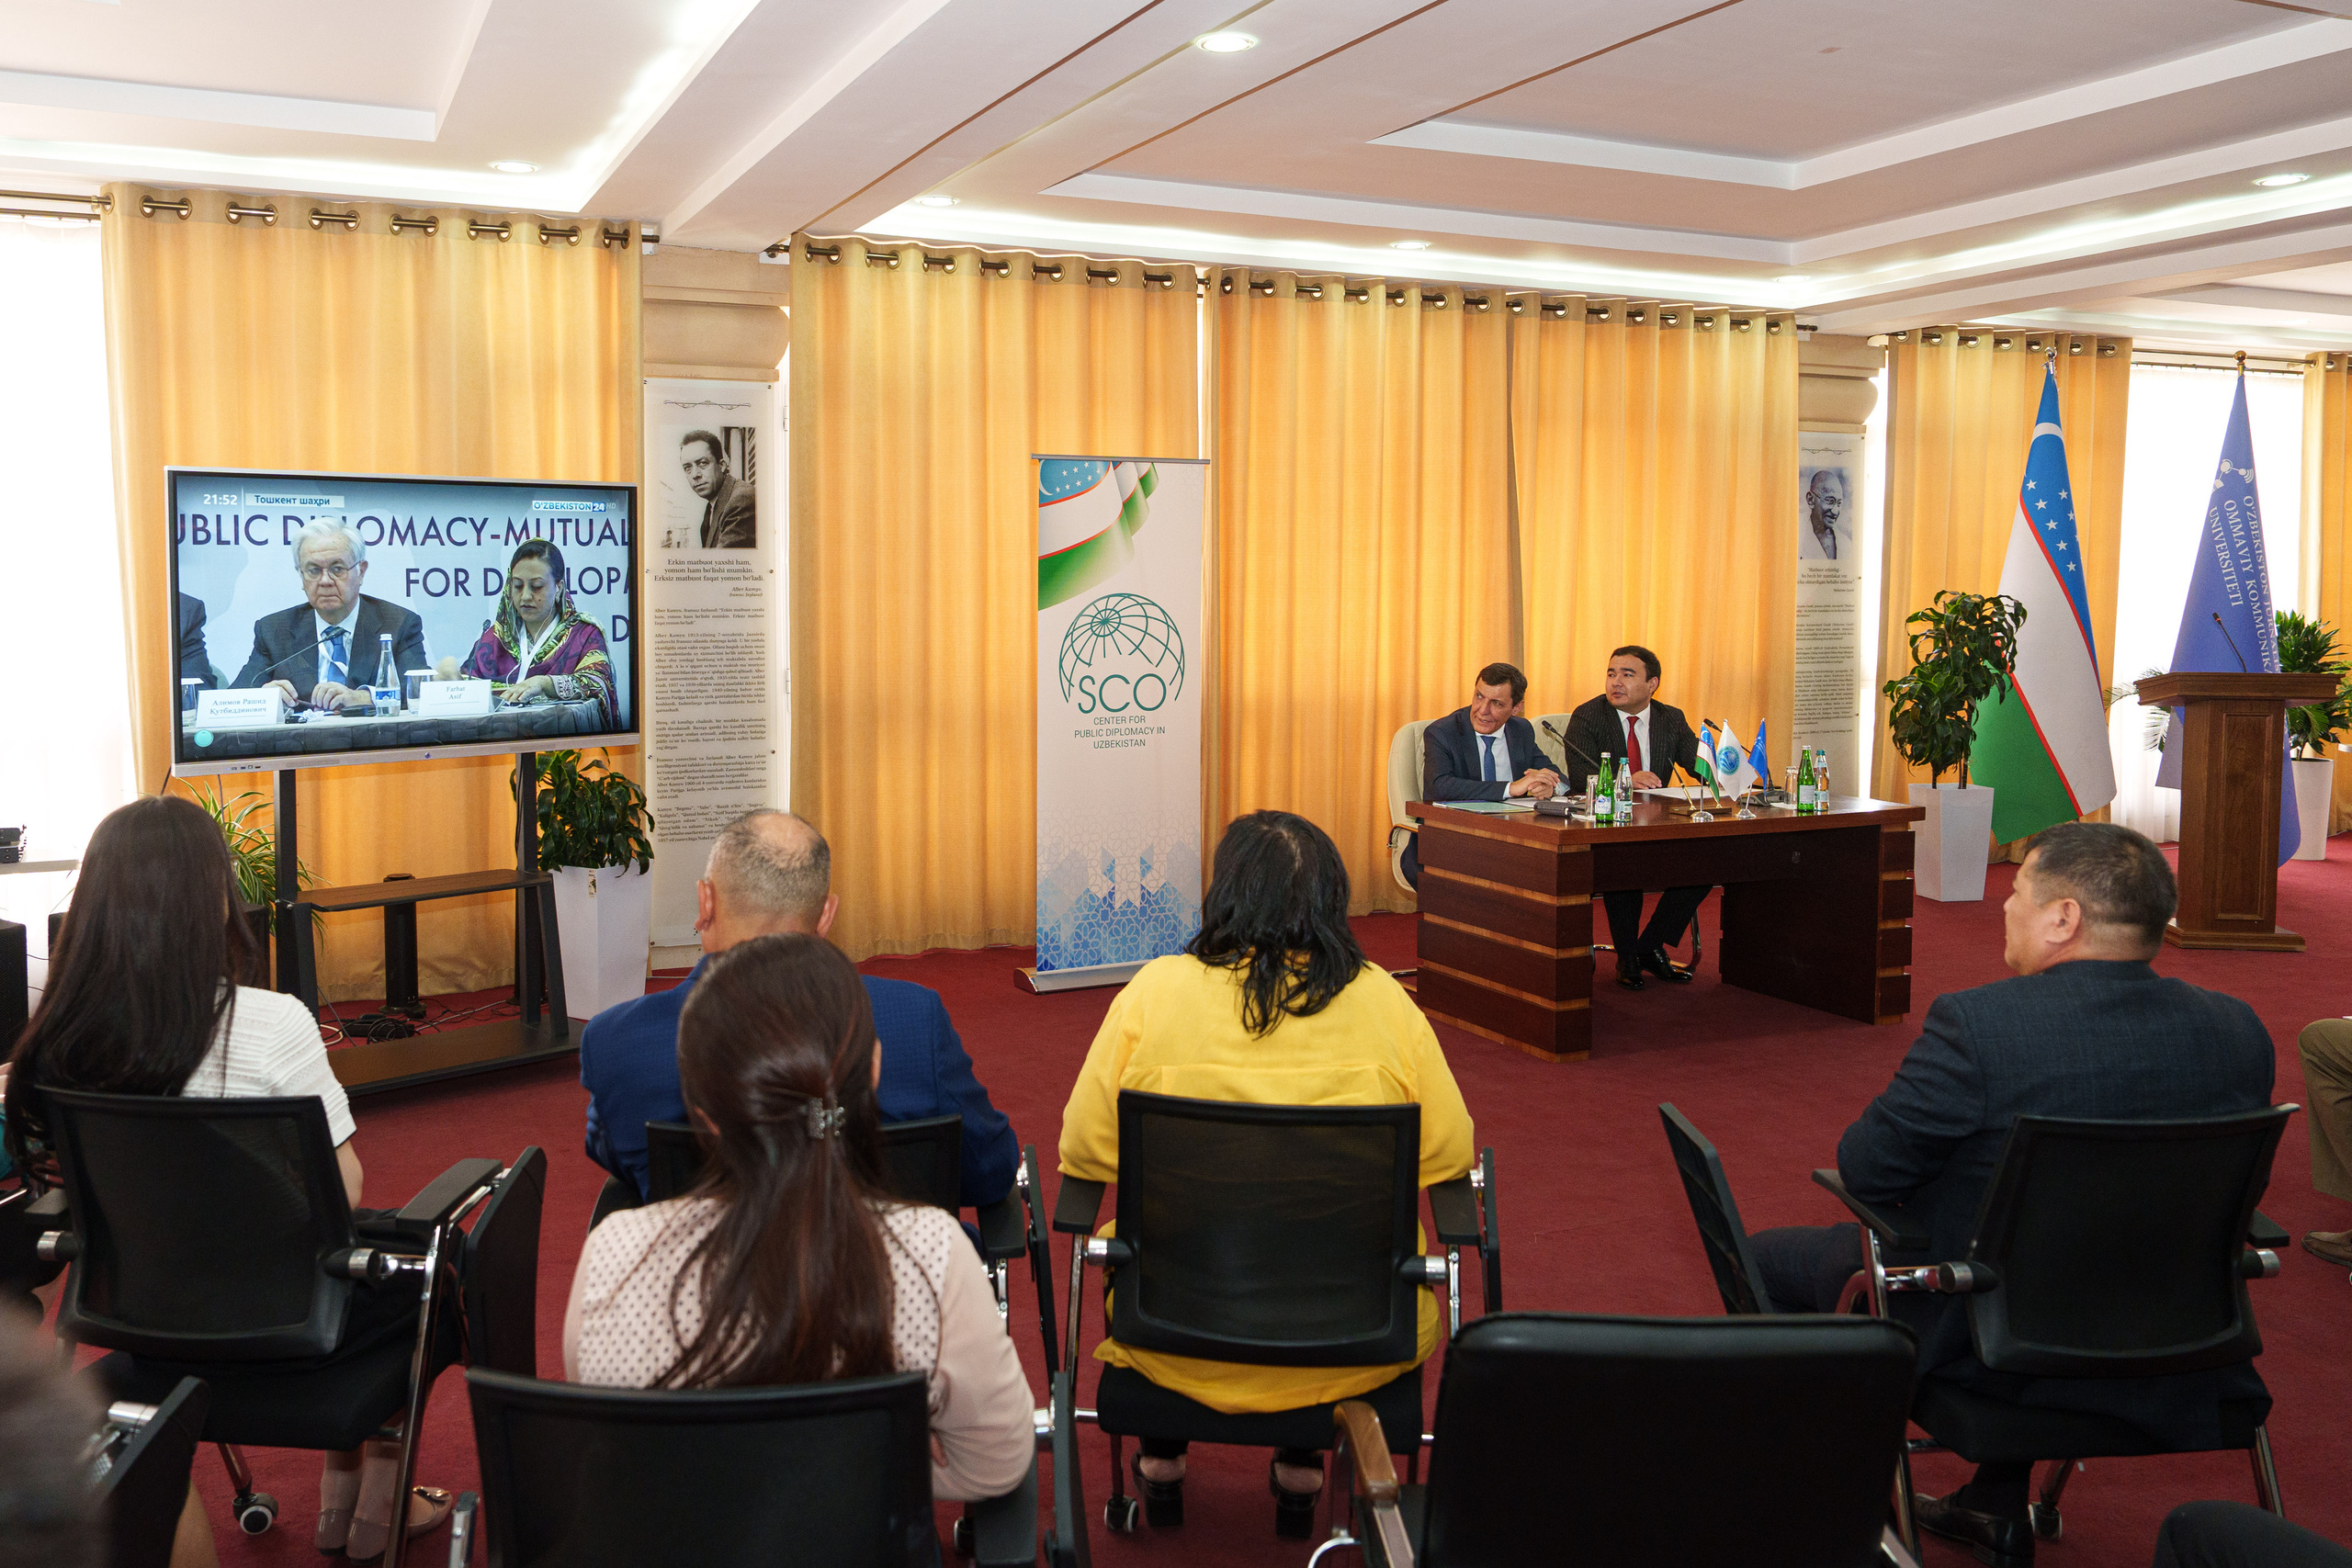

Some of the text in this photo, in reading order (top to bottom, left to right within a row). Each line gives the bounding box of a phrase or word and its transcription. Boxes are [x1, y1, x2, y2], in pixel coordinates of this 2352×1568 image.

[203, 493, 238, 505] 21:52
[254, 494, 330, 508] Тошкент шаҳри
[593, 502, 605, 512] 24
[2223, 500, 2254, 573] OMMAVIY
[714, 558, 734, 567] yaxshi
[736, 558, 752, 567] ham,
[2209, 506, 2244, 607] UNIVERSITETI
[405, 568, 471, 597] FOR
[1078, 673, 1167, 714] SCO
[243, 697, 266, 705] Рашид
[1093, 716, 1146, 726] CENTER FOR
[1074, 726, 1166, 739] PUBLIC DIPLOMACY IN
[1093, 739, 1146, 750] UZBEKISTAN
